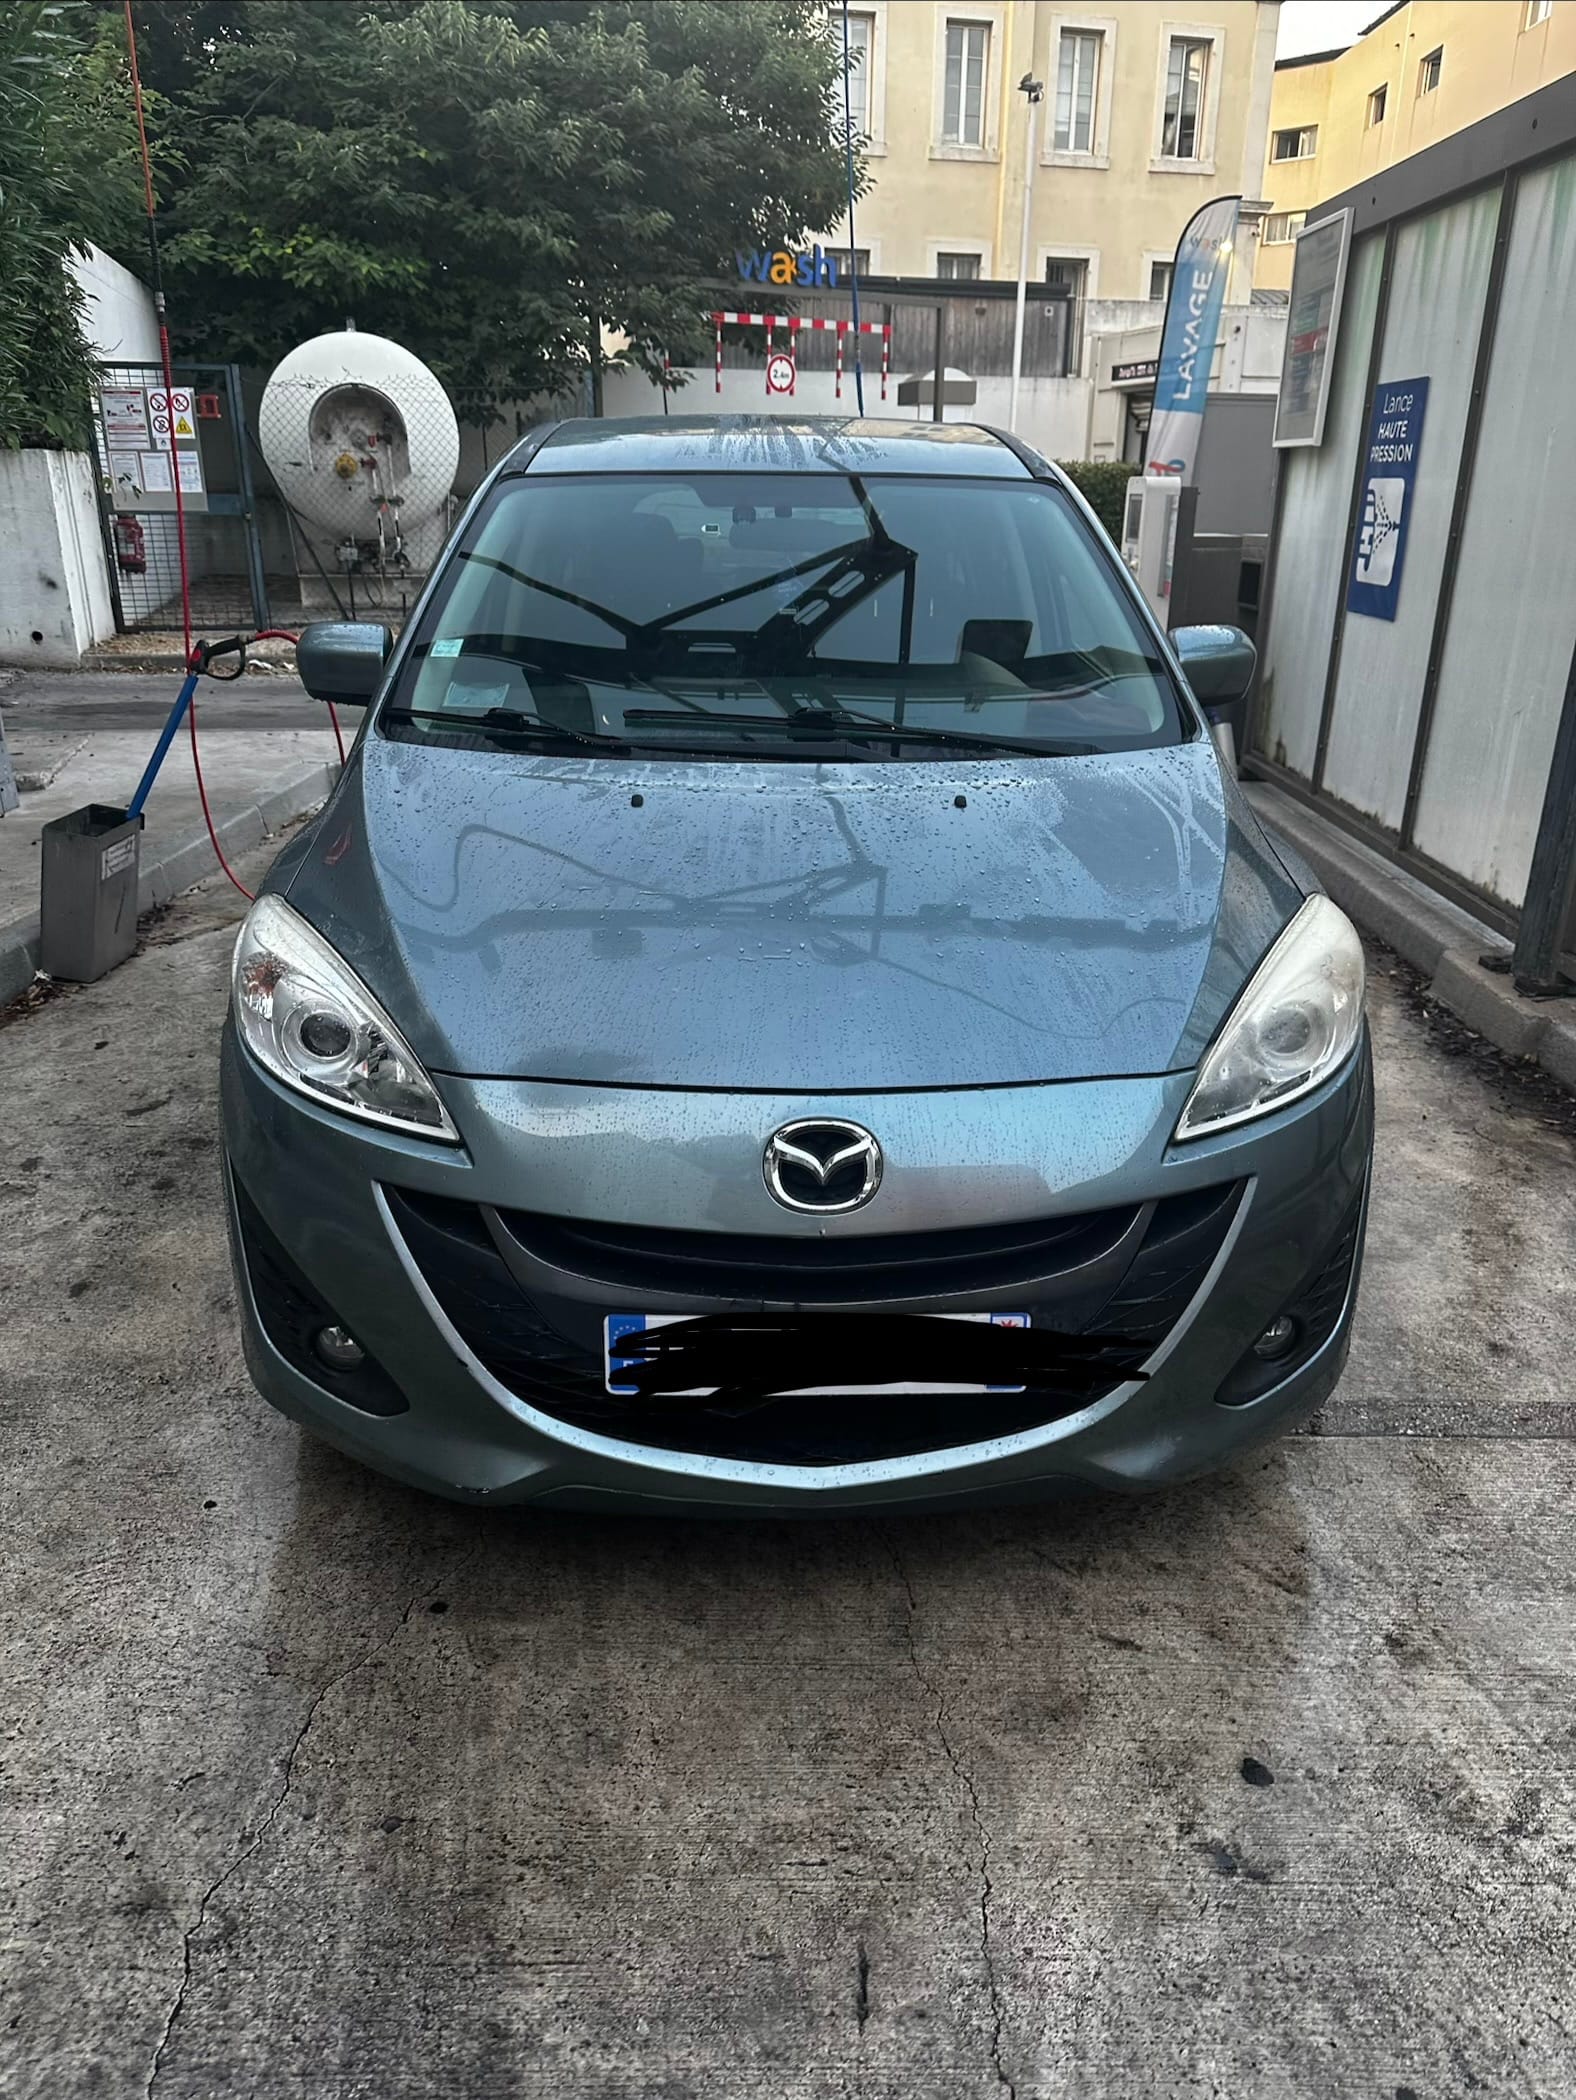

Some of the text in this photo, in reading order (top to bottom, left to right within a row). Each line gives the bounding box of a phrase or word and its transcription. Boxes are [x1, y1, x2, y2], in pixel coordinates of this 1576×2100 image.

[734, 243, 837, 288] wash
[1173, 270, 1213, 400] LAVAGE
[1383, 393, 1414, 414] Lance
[1378, 420, 1408, 439] HAUTE
[1370, 443, 1414, 462] PRESSION
